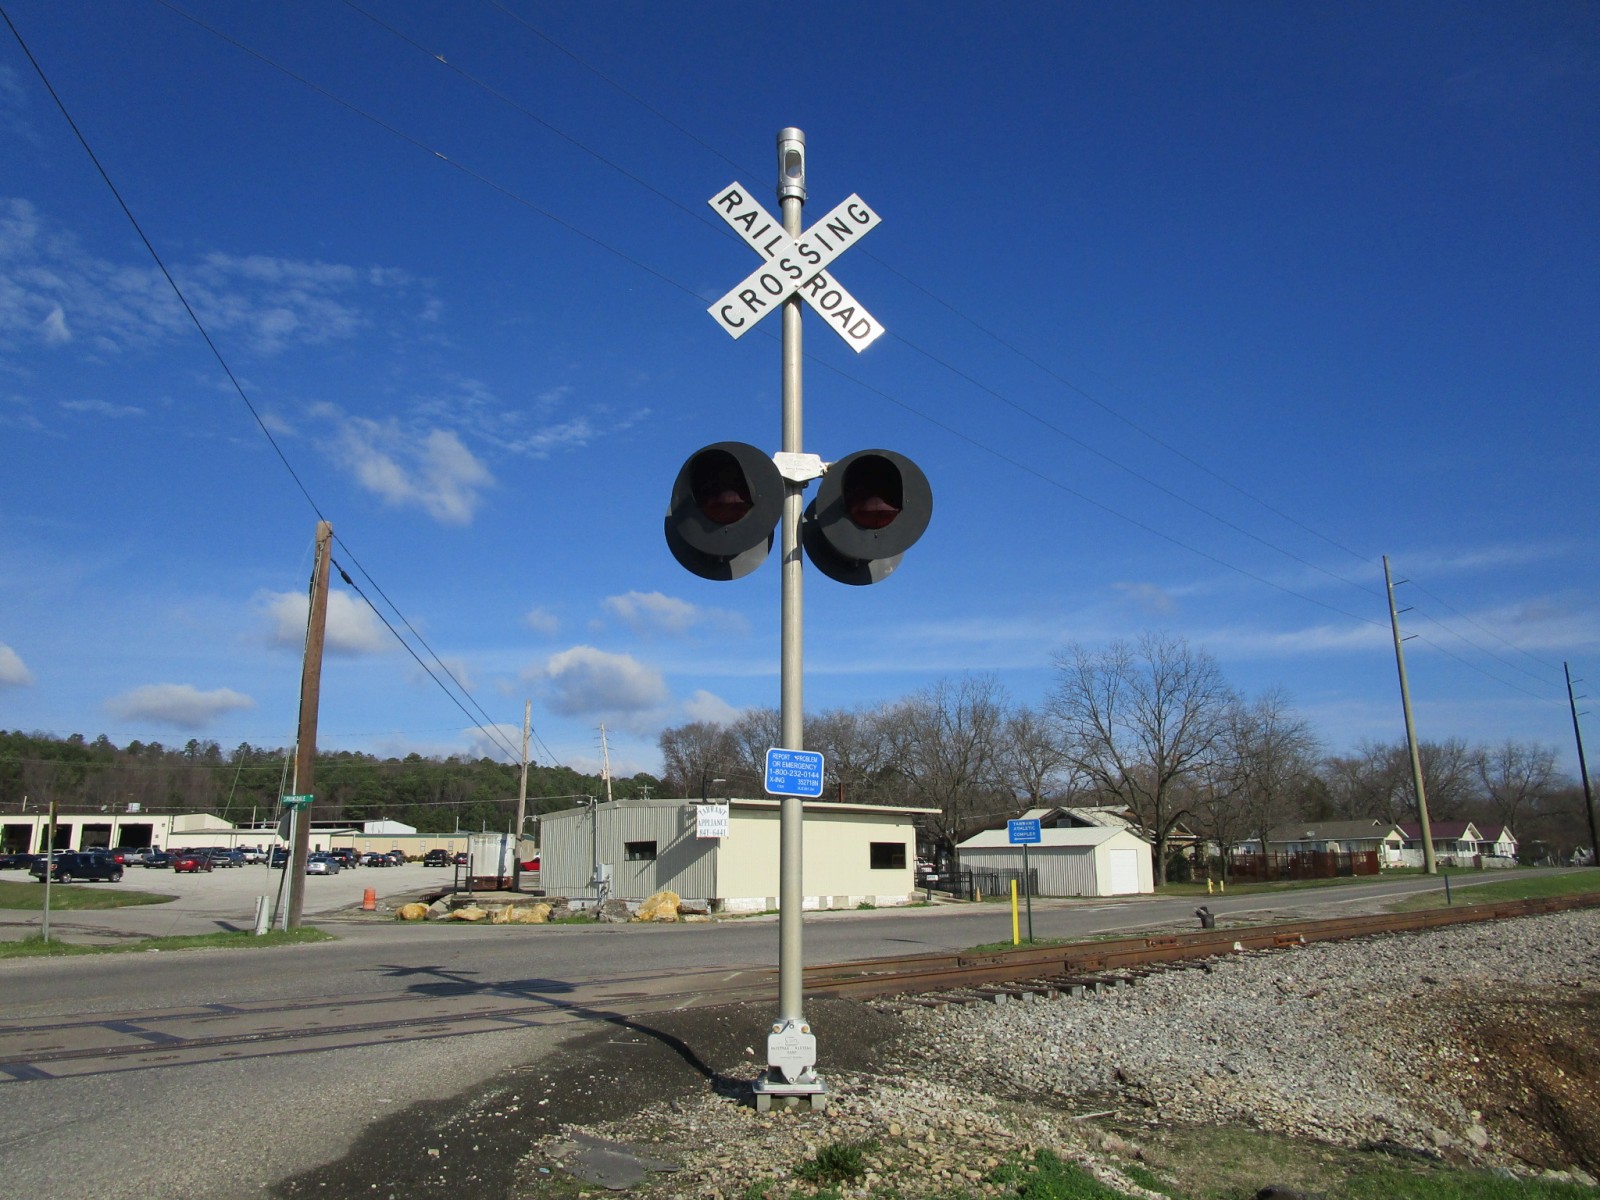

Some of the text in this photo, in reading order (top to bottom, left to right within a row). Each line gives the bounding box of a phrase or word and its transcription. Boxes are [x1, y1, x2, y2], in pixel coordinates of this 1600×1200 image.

[718, 190, 871, 339] RAIL ROAD
[721, 204, 870, 328] CROSSING
[772, 753, 818, 763] REPORT PROBLEM
[782, 762, 817, 771] EMERGENCY
[769, 768, 819, 778] 1-800-232-0144
[769, 776, 785, 784] X-ING
[698, 805, 727, 816] TARRANT
[698, 818, 728, 826] APPLIANCE
